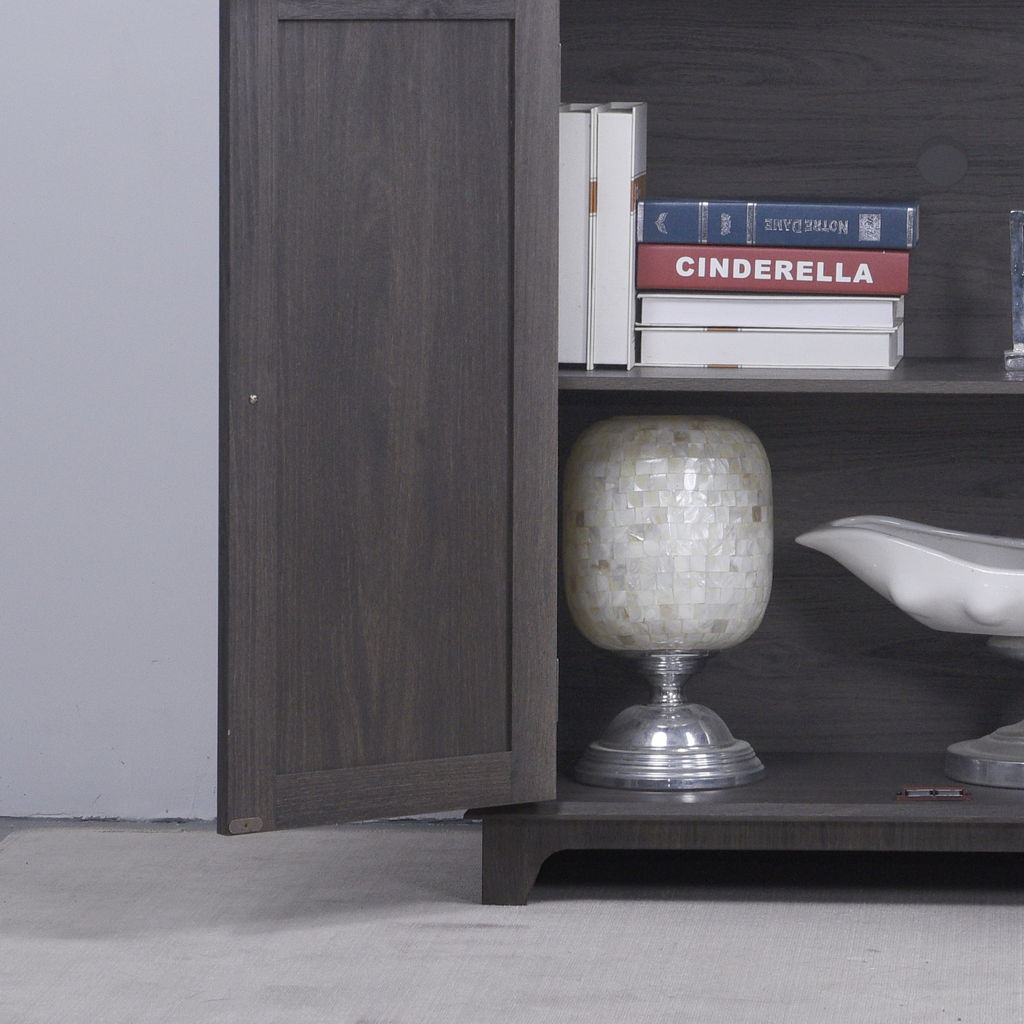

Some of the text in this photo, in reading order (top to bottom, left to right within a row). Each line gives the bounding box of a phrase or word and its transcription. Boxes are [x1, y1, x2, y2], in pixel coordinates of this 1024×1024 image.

[764, 217, 849, 235] NOTRE DAME
[675, 256, 874, 284] CINDERELLA
